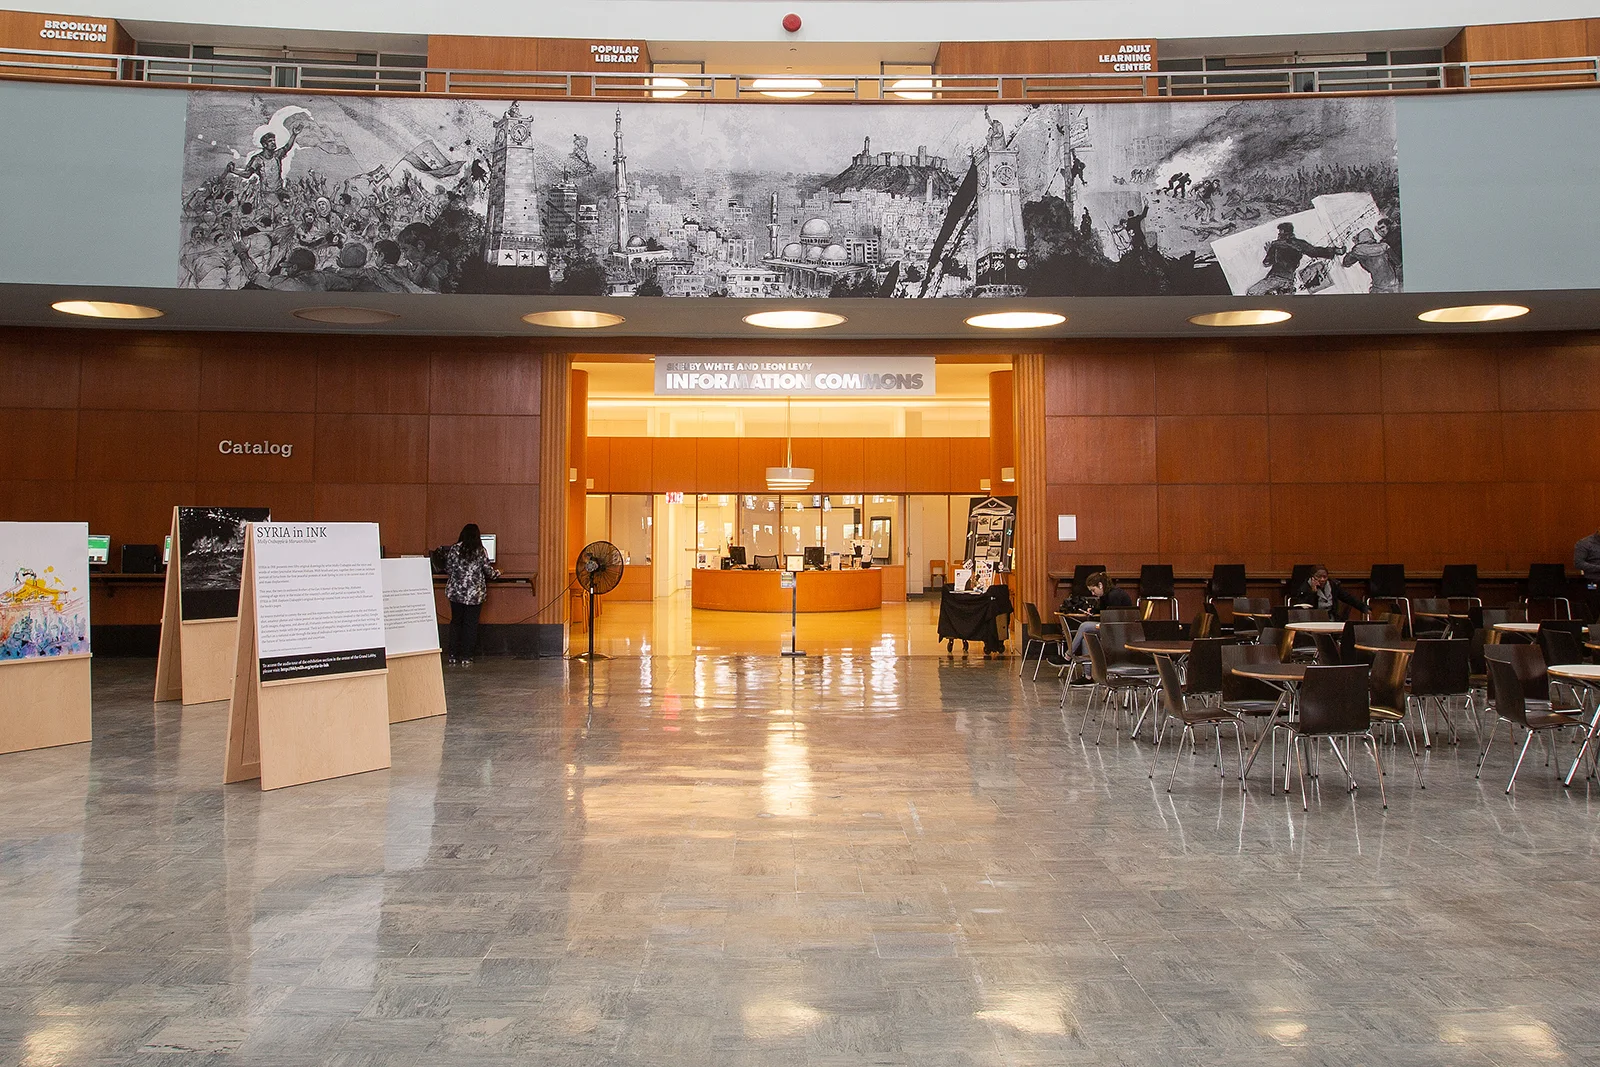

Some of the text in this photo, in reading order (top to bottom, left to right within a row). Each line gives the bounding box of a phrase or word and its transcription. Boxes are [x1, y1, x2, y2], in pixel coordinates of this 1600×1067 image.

[44, 20, 107, 32] BROOKLYN
[39, 29, 106, 42] COLLECTION
[590, 45, 639, 54] POPULAR
[1118, 44, 1151, 53] ADULT
[595, 54, 639, 63] LIBRARY
[1098, 54, 1151, 63] LEARNING
[1113, 63, 1152, 72] CENTER
[666, 363, 813, 371] SHELBY WHITE AND LEON LEVY
[666, 373, 923, 390] INFORMATION COMMONS
[218, 440, 293, 458] Catalog
[257, 526, 328, 538] SYRIA in INK
